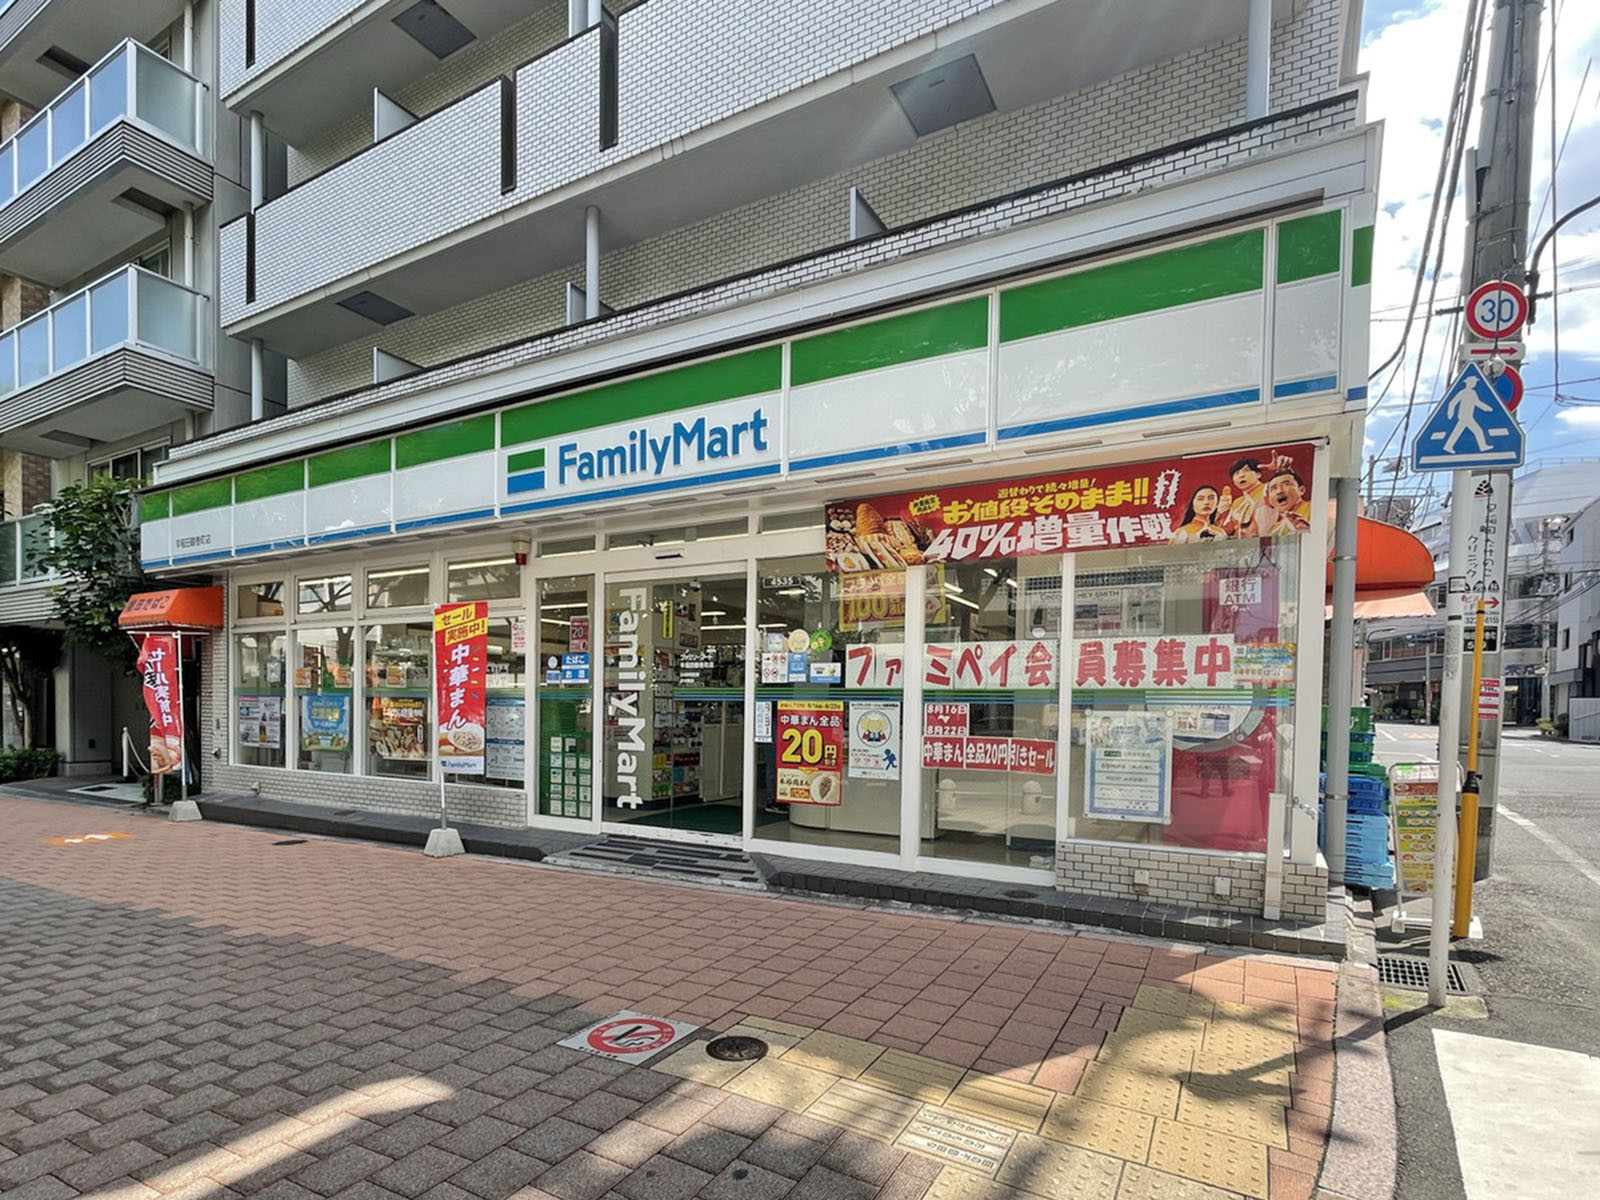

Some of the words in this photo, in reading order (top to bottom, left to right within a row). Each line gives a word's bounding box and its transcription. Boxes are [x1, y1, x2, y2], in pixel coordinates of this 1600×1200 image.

[1481, 299, 1514, 323] 30
[559, 408, 768, 485] FamilyMart
[943, 477, 1149, 525] お値段そのまま!!
[923, 512, 1176, 562] 40%増量作戦
[1466, 535, 1479, 578] クリニック
[1224, 578, 1257, 592] 銀行
[1224, 593, 1256, 604] ATM
[442, 608, 472, 626] セール
[447, 620, 485, 643] 実施中!
[565, 655, 586, 664] たばこ
[847, 637, 1232, 688] ファミペイ会員募集中
[447, 644, 470, 730] 中華まん
[611, 588, 647, 810] FamilyMart
[927, 705, 967, 714] 8月16日
[926, 726, 966, 735] 8月22日
